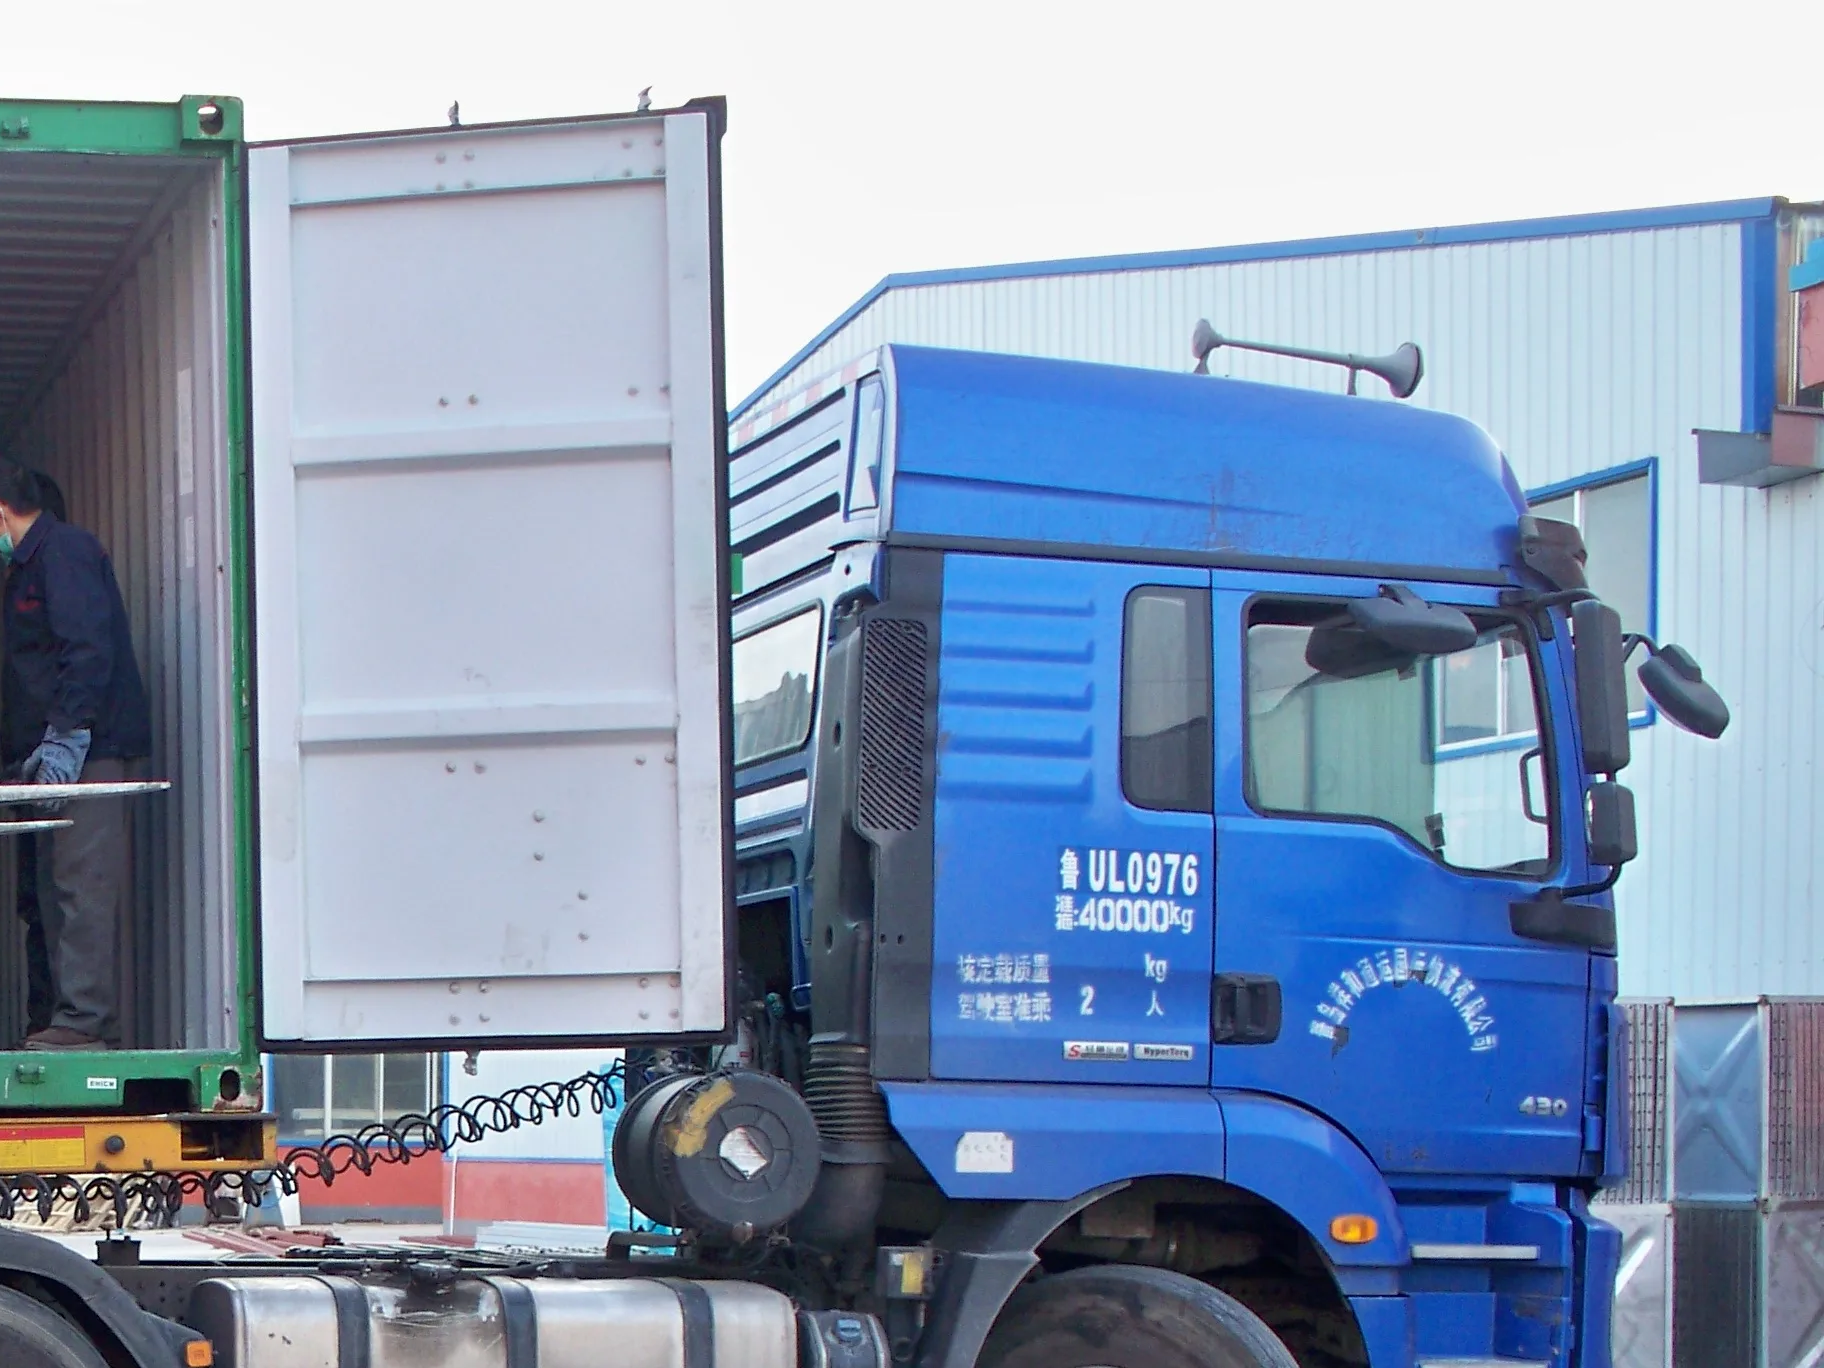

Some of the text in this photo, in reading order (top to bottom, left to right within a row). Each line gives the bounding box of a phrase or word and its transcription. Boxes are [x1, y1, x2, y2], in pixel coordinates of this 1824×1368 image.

[1060, 848, 1080, 890] 鲁
[1144, 953, 1168, 983] kg
[1080, 985, 1094, 1016] 2
[1145, 990, 1164, 1017] 人
[1519, 1096, 1568, 1116] 430
